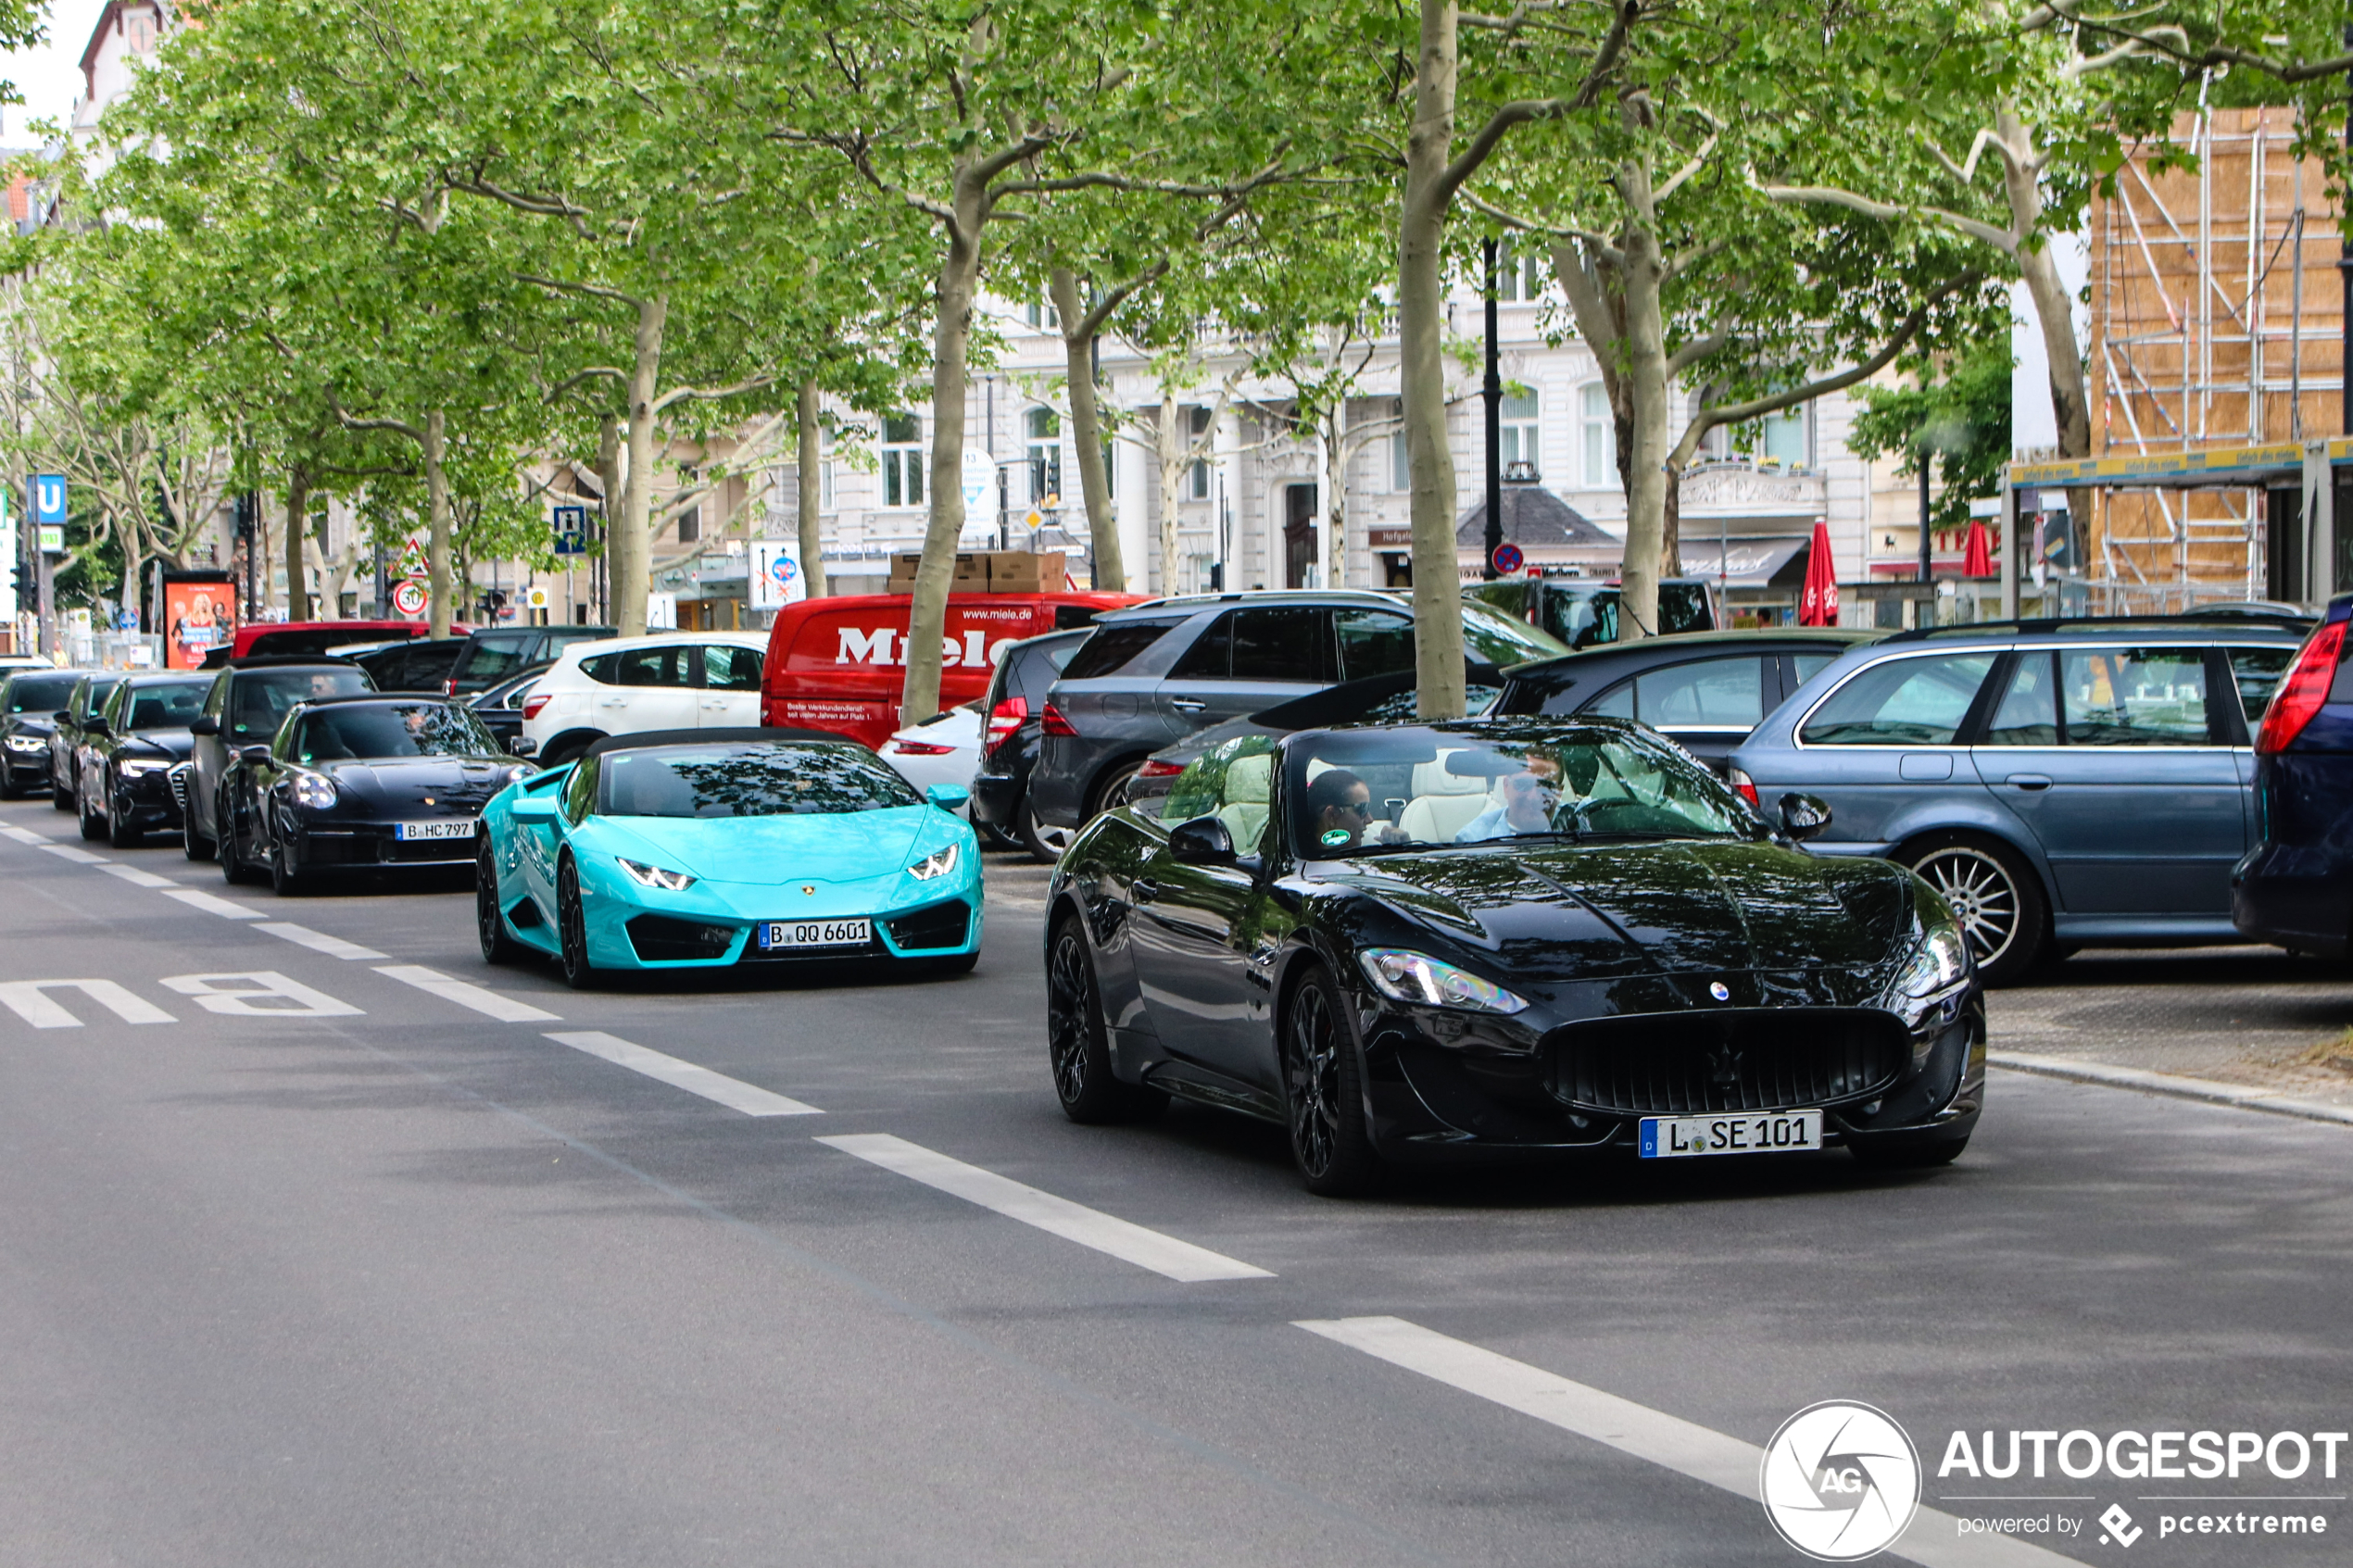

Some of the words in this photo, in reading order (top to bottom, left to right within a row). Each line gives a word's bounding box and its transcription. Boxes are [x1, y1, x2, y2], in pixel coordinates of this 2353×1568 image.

[965, 454, 977, 463] 13
[38, 483, 60, 514] U
[828, 544, 876, 555] LACOSTE
[400, 591, 420, 605] 30
[962, 608, 1033, 621] www.miele.de
[799, 711, 817, 720] vielen
[817, 711, 838, 721] Jahren
[838, 712, 849, 721] auf
[849, 712, 865, 721] Platz
[409, 824, 417, 837] B
[425, 823, 442, 837] HC
[445, 822, 469, 836] 797
[771, 926, 783, 944] B
[795, 924, 819, 943] QQ
[824, 922, 868, 941] 6601
[1644, 1141, 1653, 1151] D
[1670, 1123, 1689, 1151] L
[1710, 1119, 1748, 1149] SE
[1755, 1117, 1809, 1148] 101
